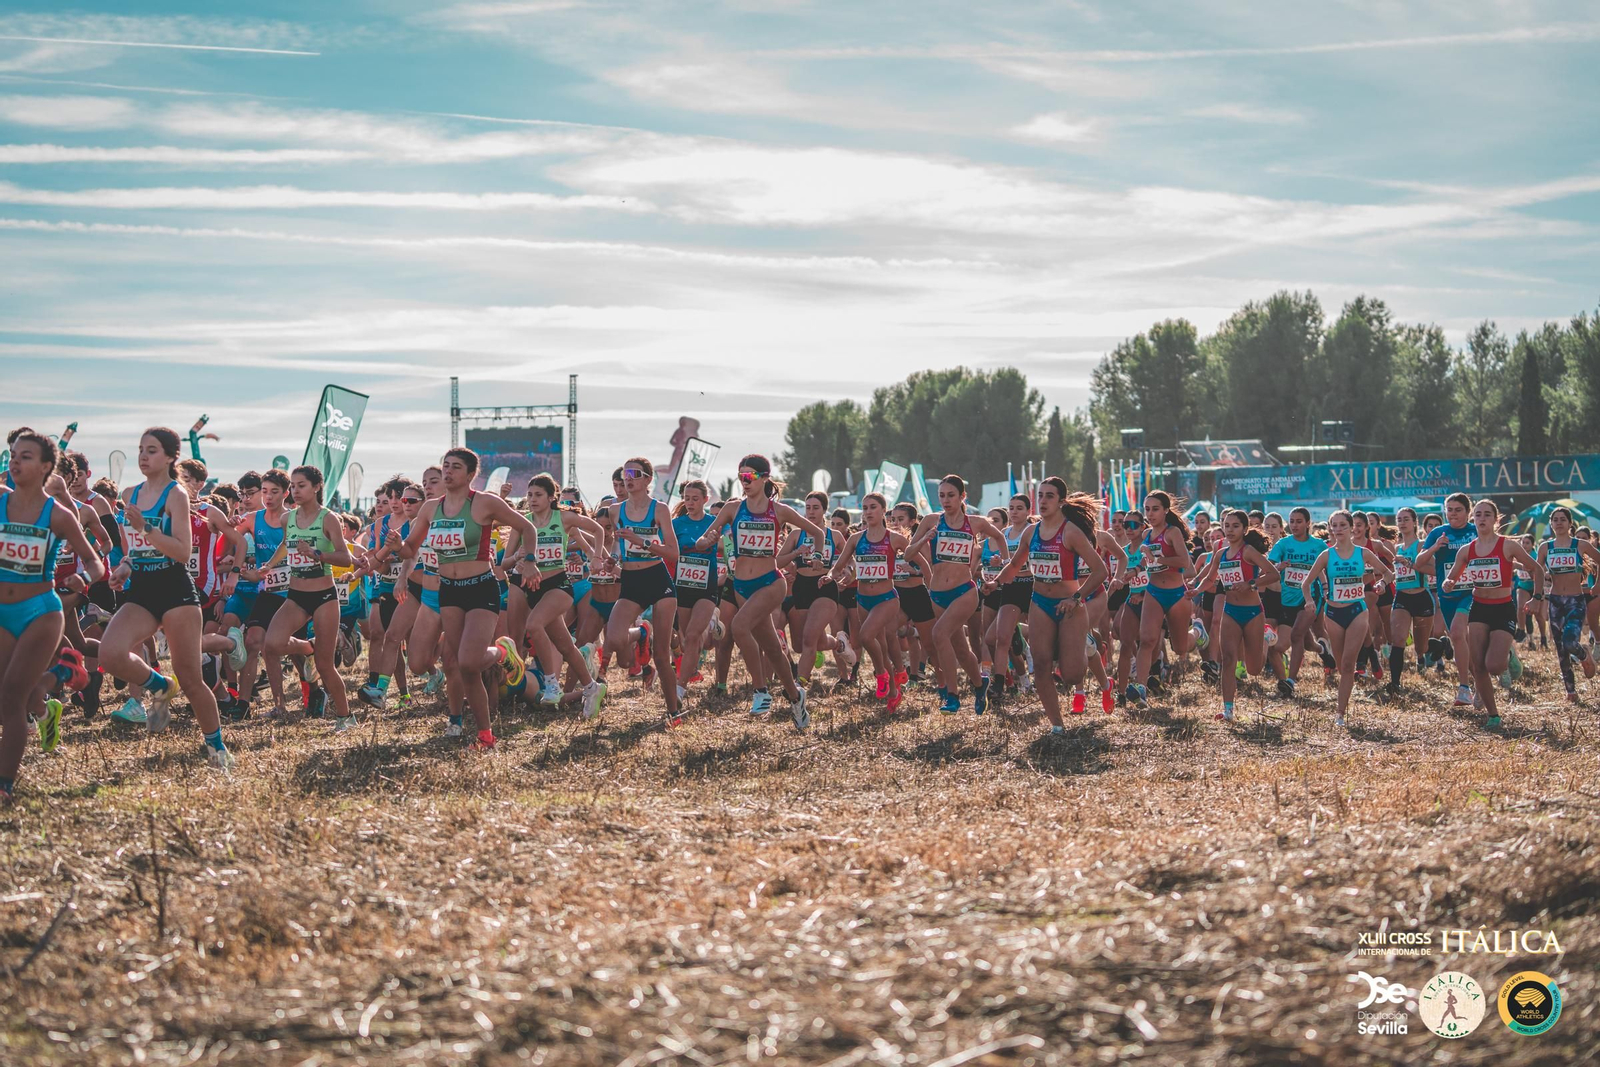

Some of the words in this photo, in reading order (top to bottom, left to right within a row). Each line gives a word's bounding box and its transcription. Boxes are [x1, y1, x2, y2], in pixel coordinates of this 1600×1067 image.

[1329, 467, 1391, 491] XLIII
[1392, 465, 1442, 480] CROSS
[1464, 457, 1586, 488] ITÁLICA
[1221, 477, 1261, 485] CAMPEONATO
[1392, 479, 1460, 489] INTERNACIONAL
[1329, 489, 1388, 499] INTERNATIONAL
[1389, 488, 1413, 497] CROSS
[1413, 486, 1448, 496] COUNTRY
[430, 533, 461, 546] 7445
[740, 534, 772, 548] 7472
[538, 547, 562, 560] 516
[940, 541, 969, 555] 7471
[1287, 552, 1315, 562] nerja
[1550, 556, 1575, 566] 7430
[143, 561, 170, 572] NIKE
[858, 566, 886, 576] 7470
[1031, 563, 1059, 575] 7474
[267, 571, 291, 584] 813
[680, 567, 706, 580] 7462
[1287, 571, 1308, 581] 749
[1470, 569, 1498, 581] 5473
[454, 577, 479, 587] NIKE
[1336, 586, 1363, 599] 7498
